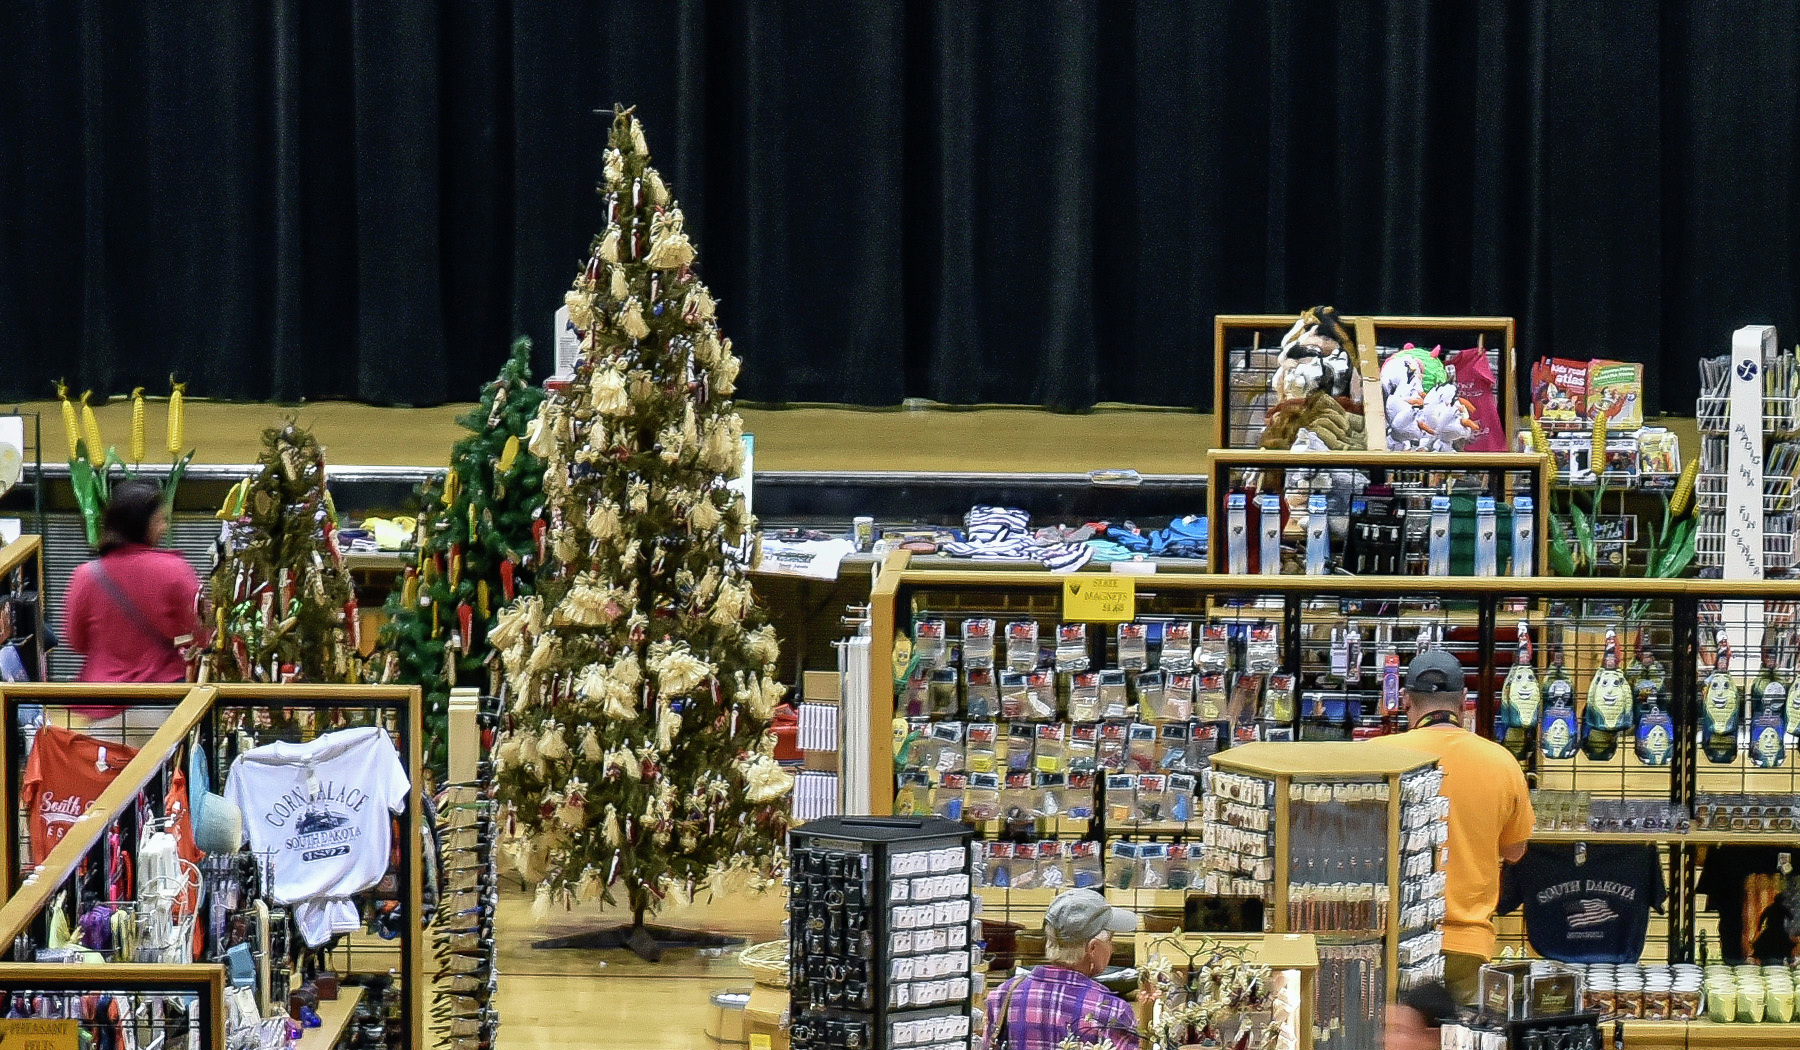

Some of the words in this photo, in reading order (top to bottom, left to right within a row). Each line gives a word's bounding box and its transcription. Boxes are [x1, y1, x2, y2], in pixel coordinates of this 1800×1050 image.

[1555, 374, 1585, 387] atlas
[1735, 424, 1761, 465] MAGIC
[1740, 505, 1756, 530] FUN
[40, 791, 81, 815] South
[1537, 880, 1580, 903] SOUTH
[1586, 880, 1636, 901] DAKOTA
